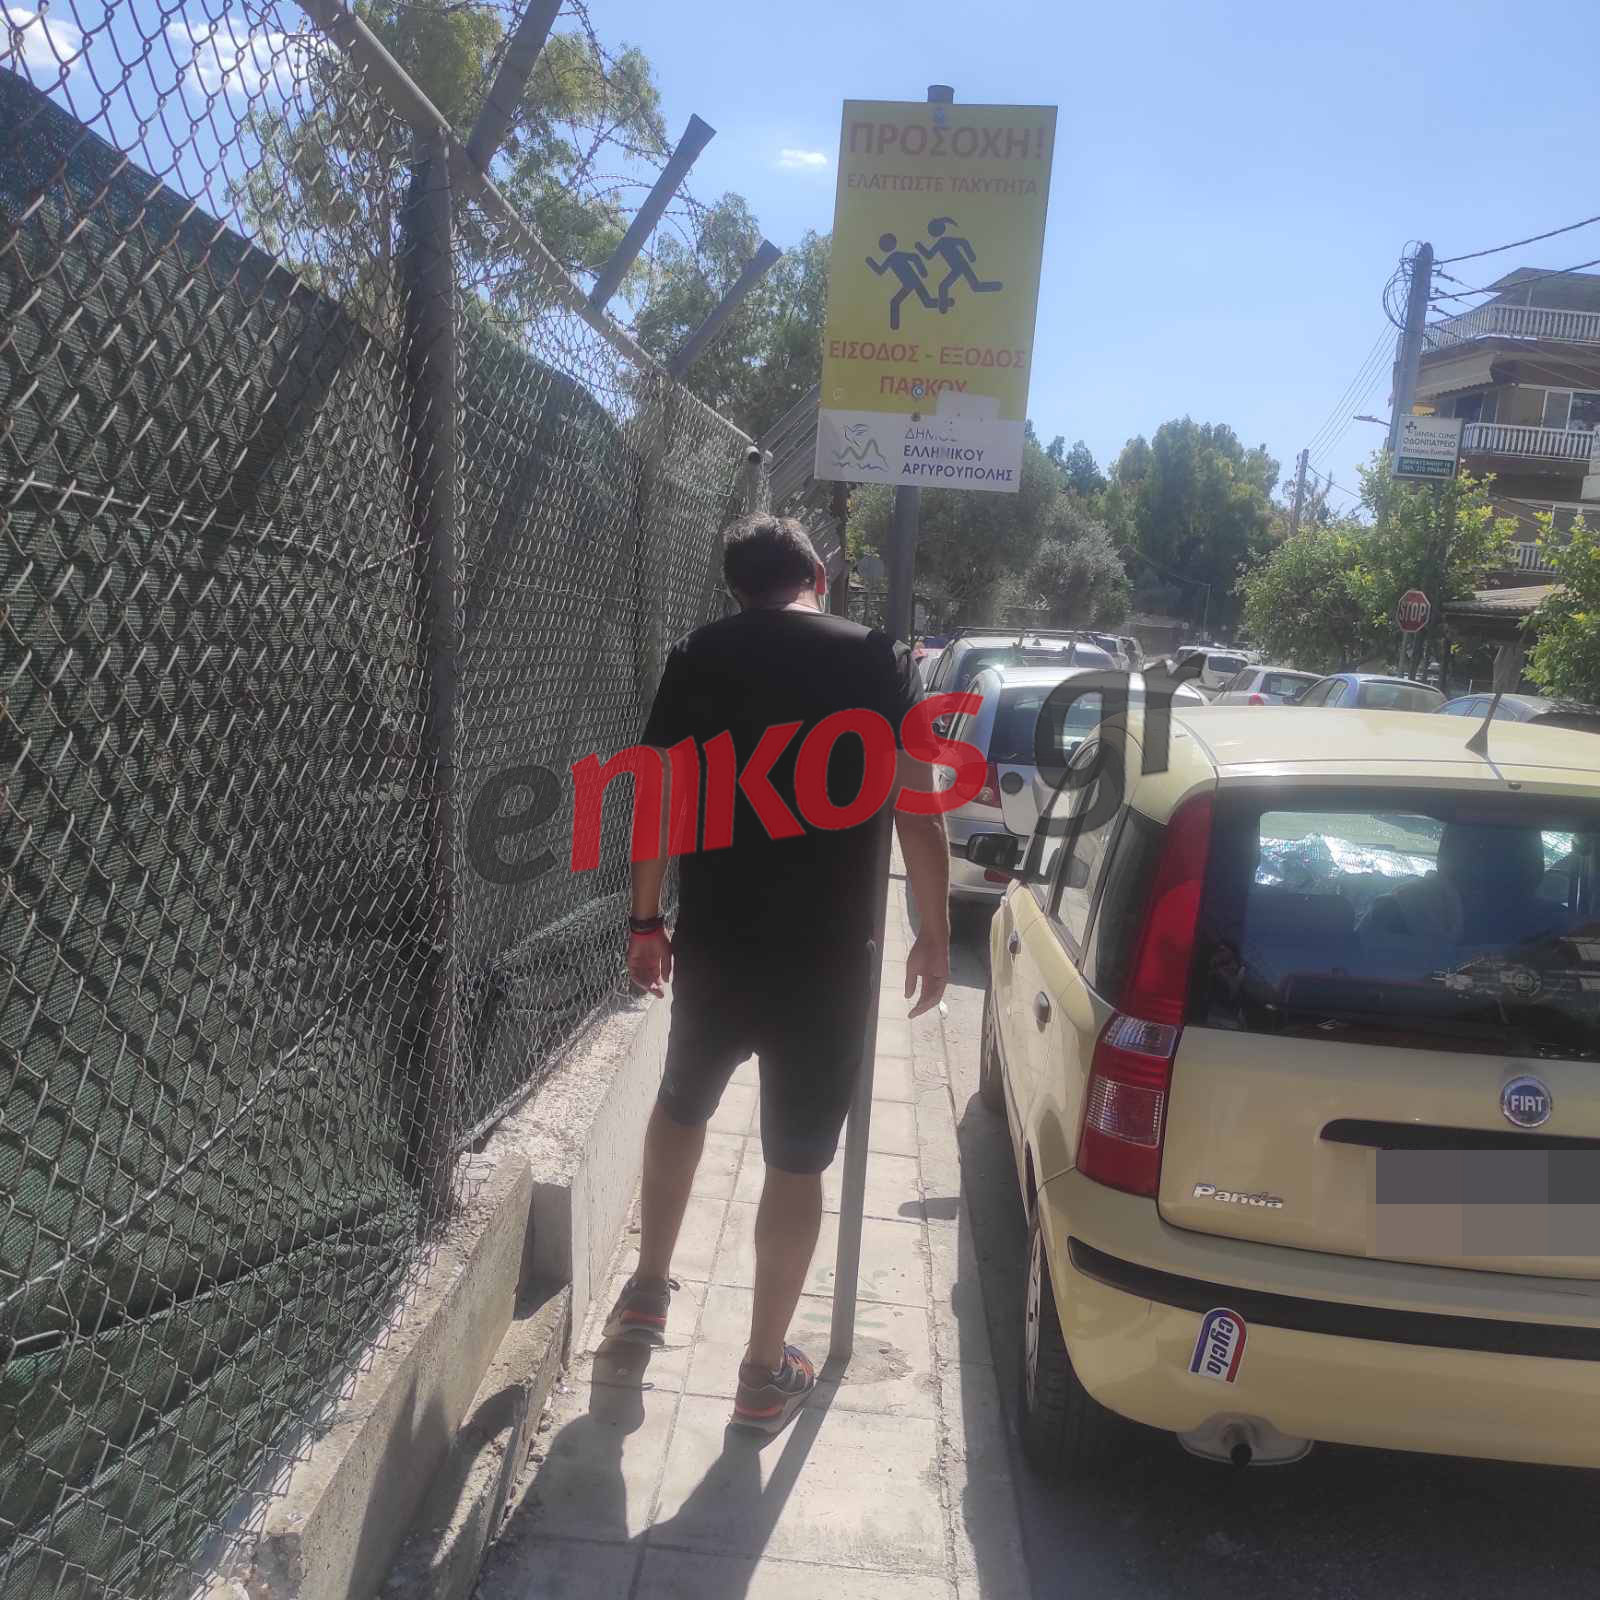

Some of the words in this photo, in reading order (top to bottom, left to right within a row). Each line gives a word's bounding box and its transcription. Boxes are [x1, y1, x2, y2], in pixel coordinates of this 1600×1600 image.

[850, 121, 1044, 160] ΠΡΟΣΟΧΗ!
[848, 173, 945, 193] ΕΛΑΤΤΩΣΤΕ
[950, 176, 1038, 196] ΤΑΧΥΤΗΤΑ
[829, 340, 919, 363] ΕΙΣΟΔΟΣ
[939, 346, 1026, 369] ΕΞΟΔΟΣ
[902, 462, 1014, 482] ΑΡΓΥΡΟΥΠΟΛΗΣ
[1400, 600, 1427, 622] STOP
[1511, 1095, 1545, 1113] FIAT
[1193, 1182, 1284, 1209] Panda
